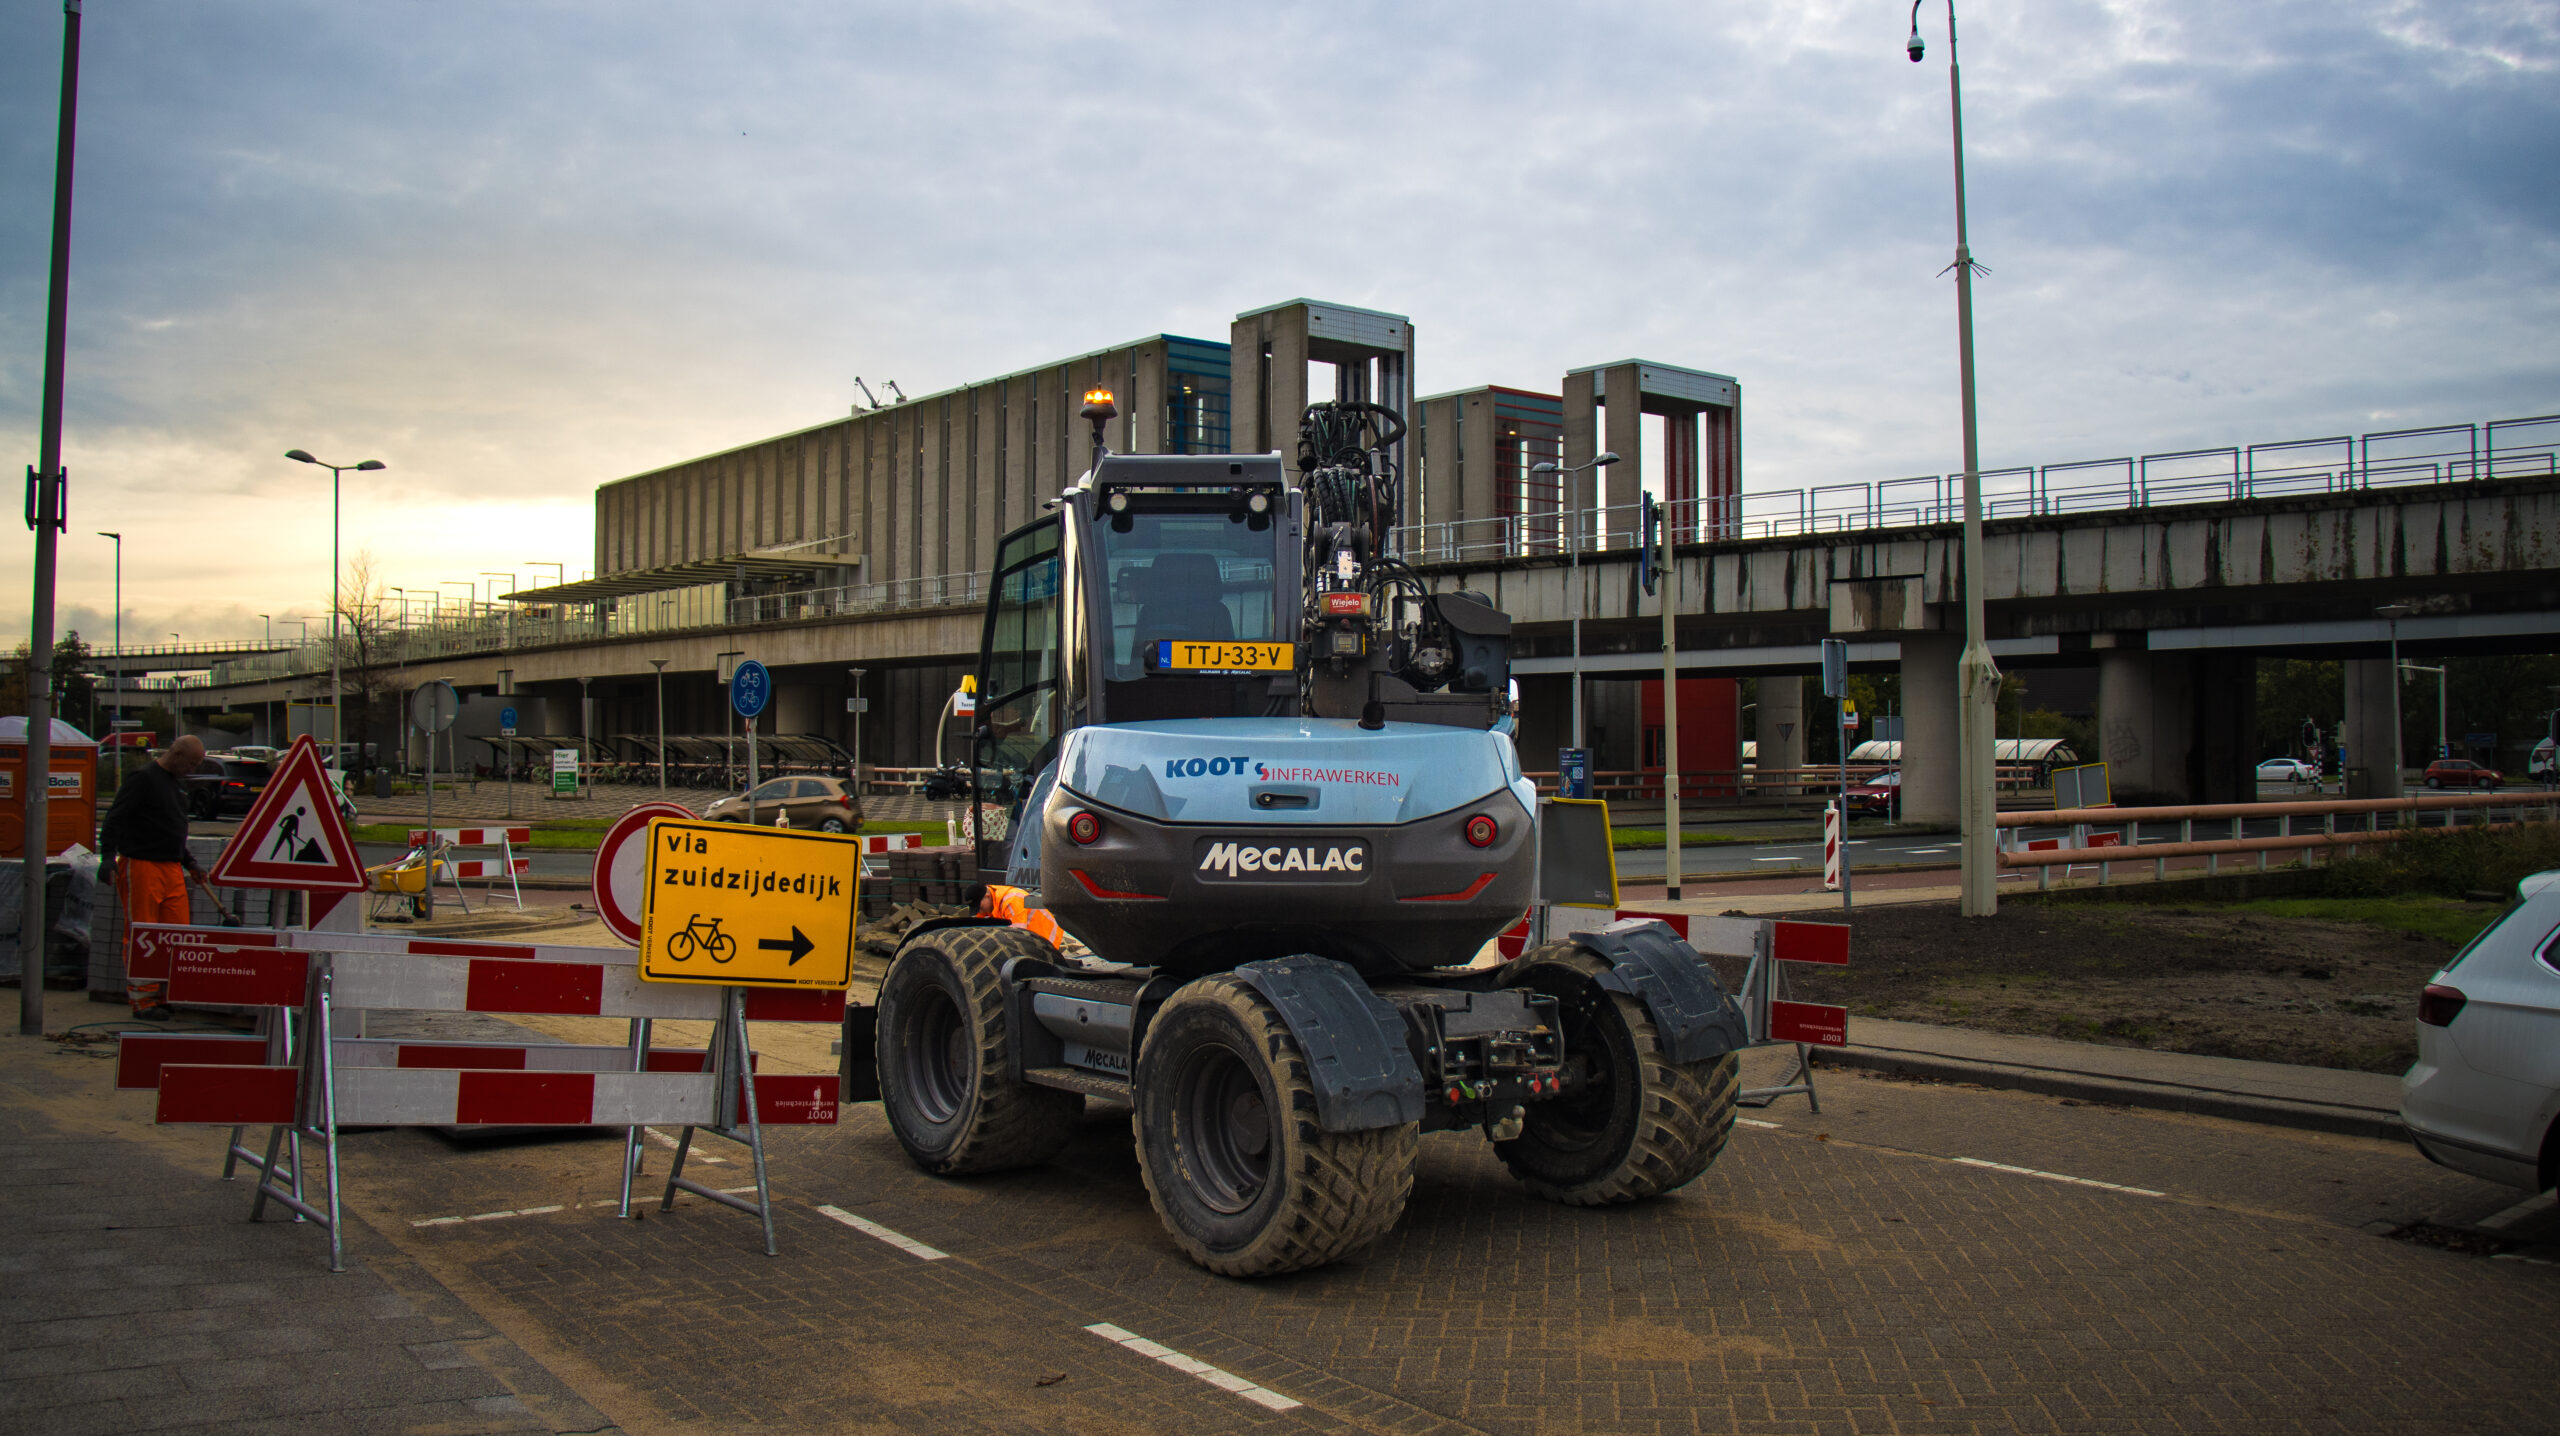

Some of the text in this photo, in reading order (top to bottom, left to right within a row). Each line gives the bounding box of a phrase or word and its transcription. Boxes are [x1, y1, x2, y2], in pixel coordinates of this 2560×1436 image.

[1331, 598, 1360, 607] Wiejelo
[1161, 656, 1170, 664] NL
[1184, 645, 1281, 666] TTJ-33-V
[1166, 756, 1399, 787] KOOT INFRAWERKEN
[48, 777, 79, 787] Boels
[667, 832, 707, 853] via
[665, 866, 840, 901] zuidzijdedijk
[158, 931, 208, 944] KOOT
[179, 951, 214, 962] KOOT
[177, 965, 256, 976] verkeerstechniek
[808, 1110, 833, 1120] KOOT
